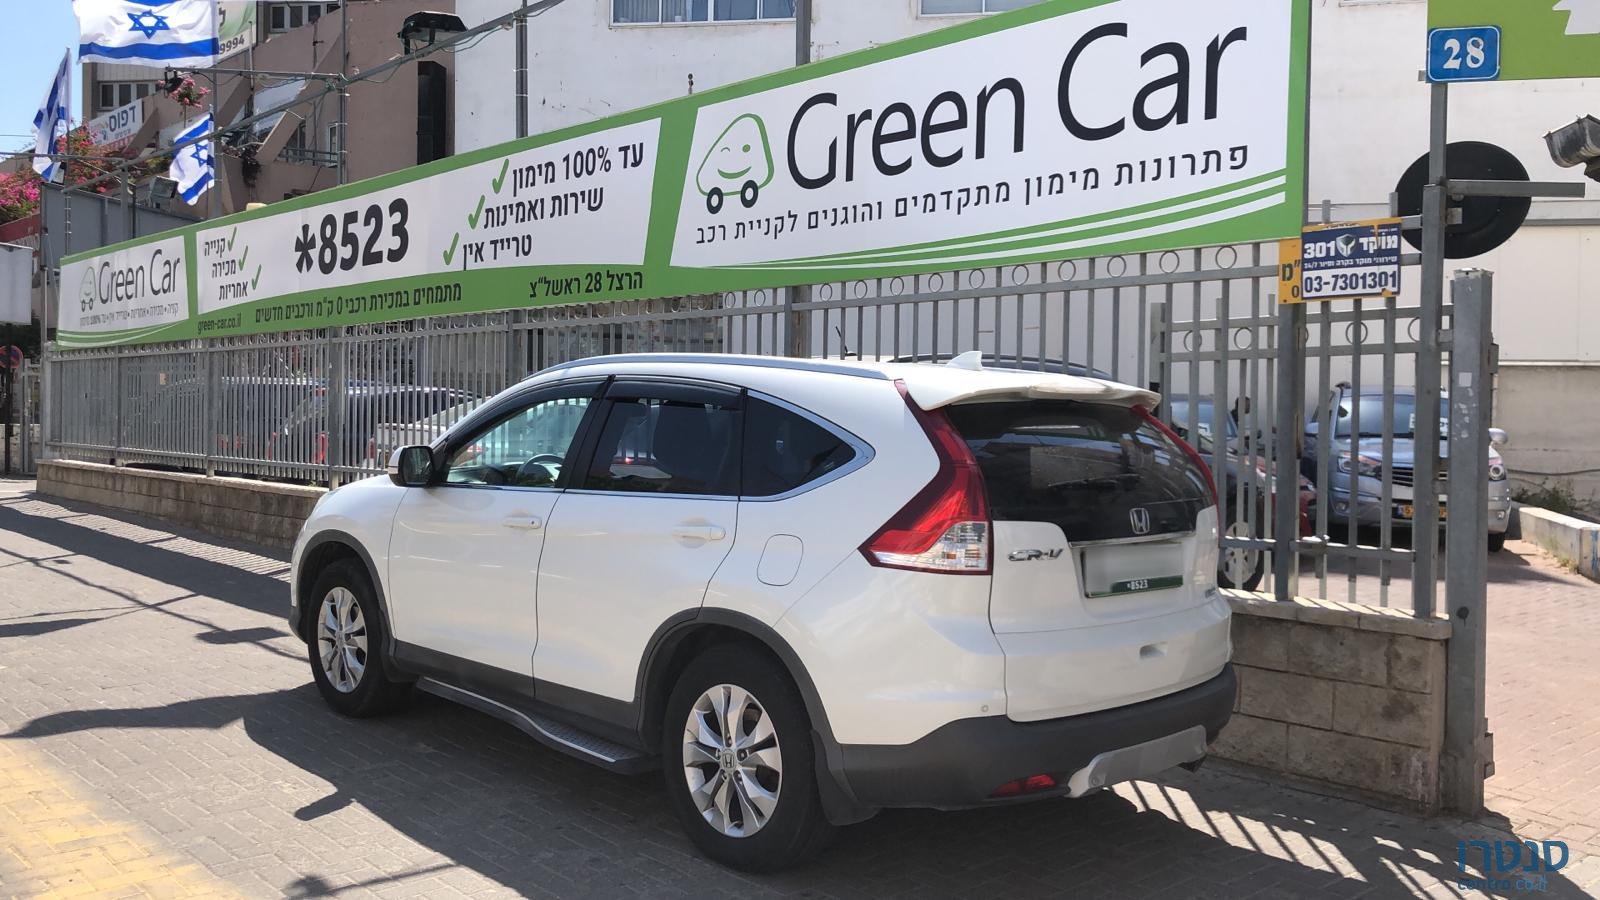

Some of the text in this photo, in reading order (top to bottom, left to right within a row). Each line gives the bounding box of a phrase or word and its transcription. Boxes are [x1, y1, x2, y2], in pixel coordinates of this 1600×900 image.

[1443, 37, 1485, 70] 28
[787, 22, 1248, 190] Green Car
[109, 105, 136, 132] דפוס
[513, 142, 644, 197] עד 100% מימון
[696, 145, 1248, 245] פתרונות מימון מתקדמים והוגנים לקניית רכב
[484, 187, 604, 229] שירות ואמינות
[204, 238, 226, 258] קנייה
[463, 234, 532, 271] טרייד אין
[1304, 241, 1336, 259] 301
[99, 249, 181, 304] Green Car
[212, 259, 237, 278] מכירה
[219, 281, 248, 301] אחריות
[585, 272, 602, 293] 28
[607, 270, 643, 291] הרצל
[1304, 270, 1397, 293] 03-7301301
[346, 296, 367, 314] רכבי
[370, 290, 410, 312] במכירת
[414, 283, 461, 305] מתמחים
[255, 306, 283, 323] חדשים
[286, 304, 313, 320] ורכבים
[198, 312, 242, 335] green-car.co.il
[1008, 549, 1063, 561] CR-V
